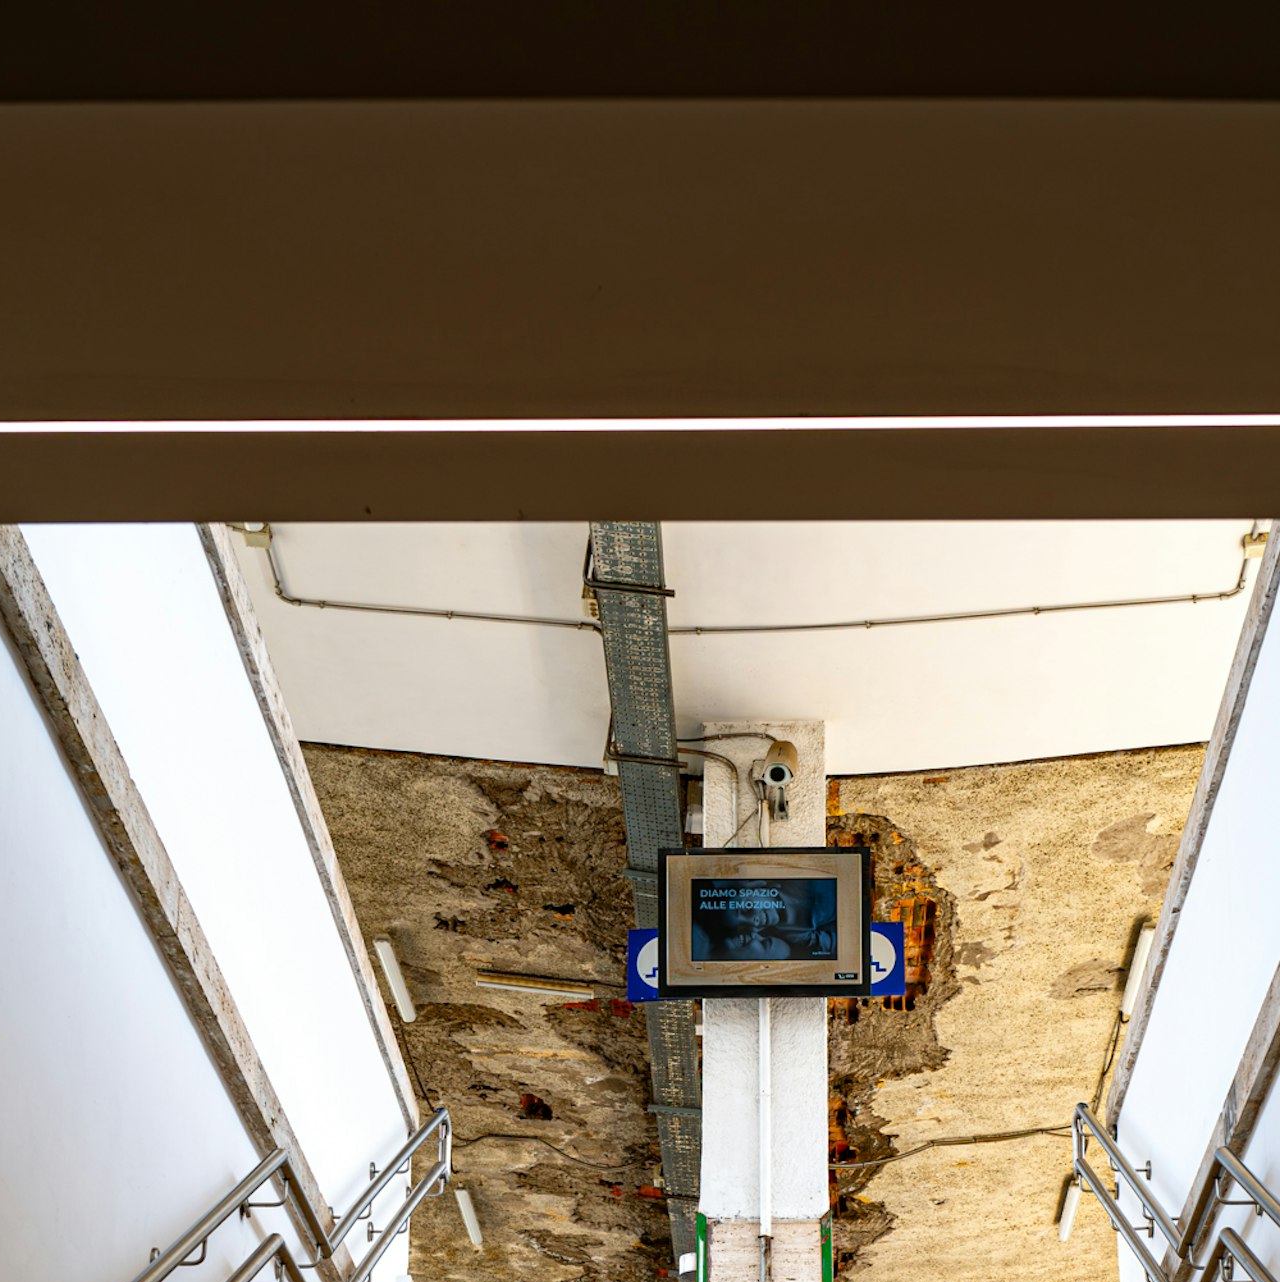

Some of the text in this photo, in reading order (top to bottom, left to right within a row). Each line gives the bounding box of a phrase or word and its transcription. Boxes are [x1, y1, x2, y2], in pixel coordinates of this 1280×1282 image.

[700, 888, 779, 898] DIAMO SPAZIO
[699, 900, 786, 910] ALLE EMOZIONI.
